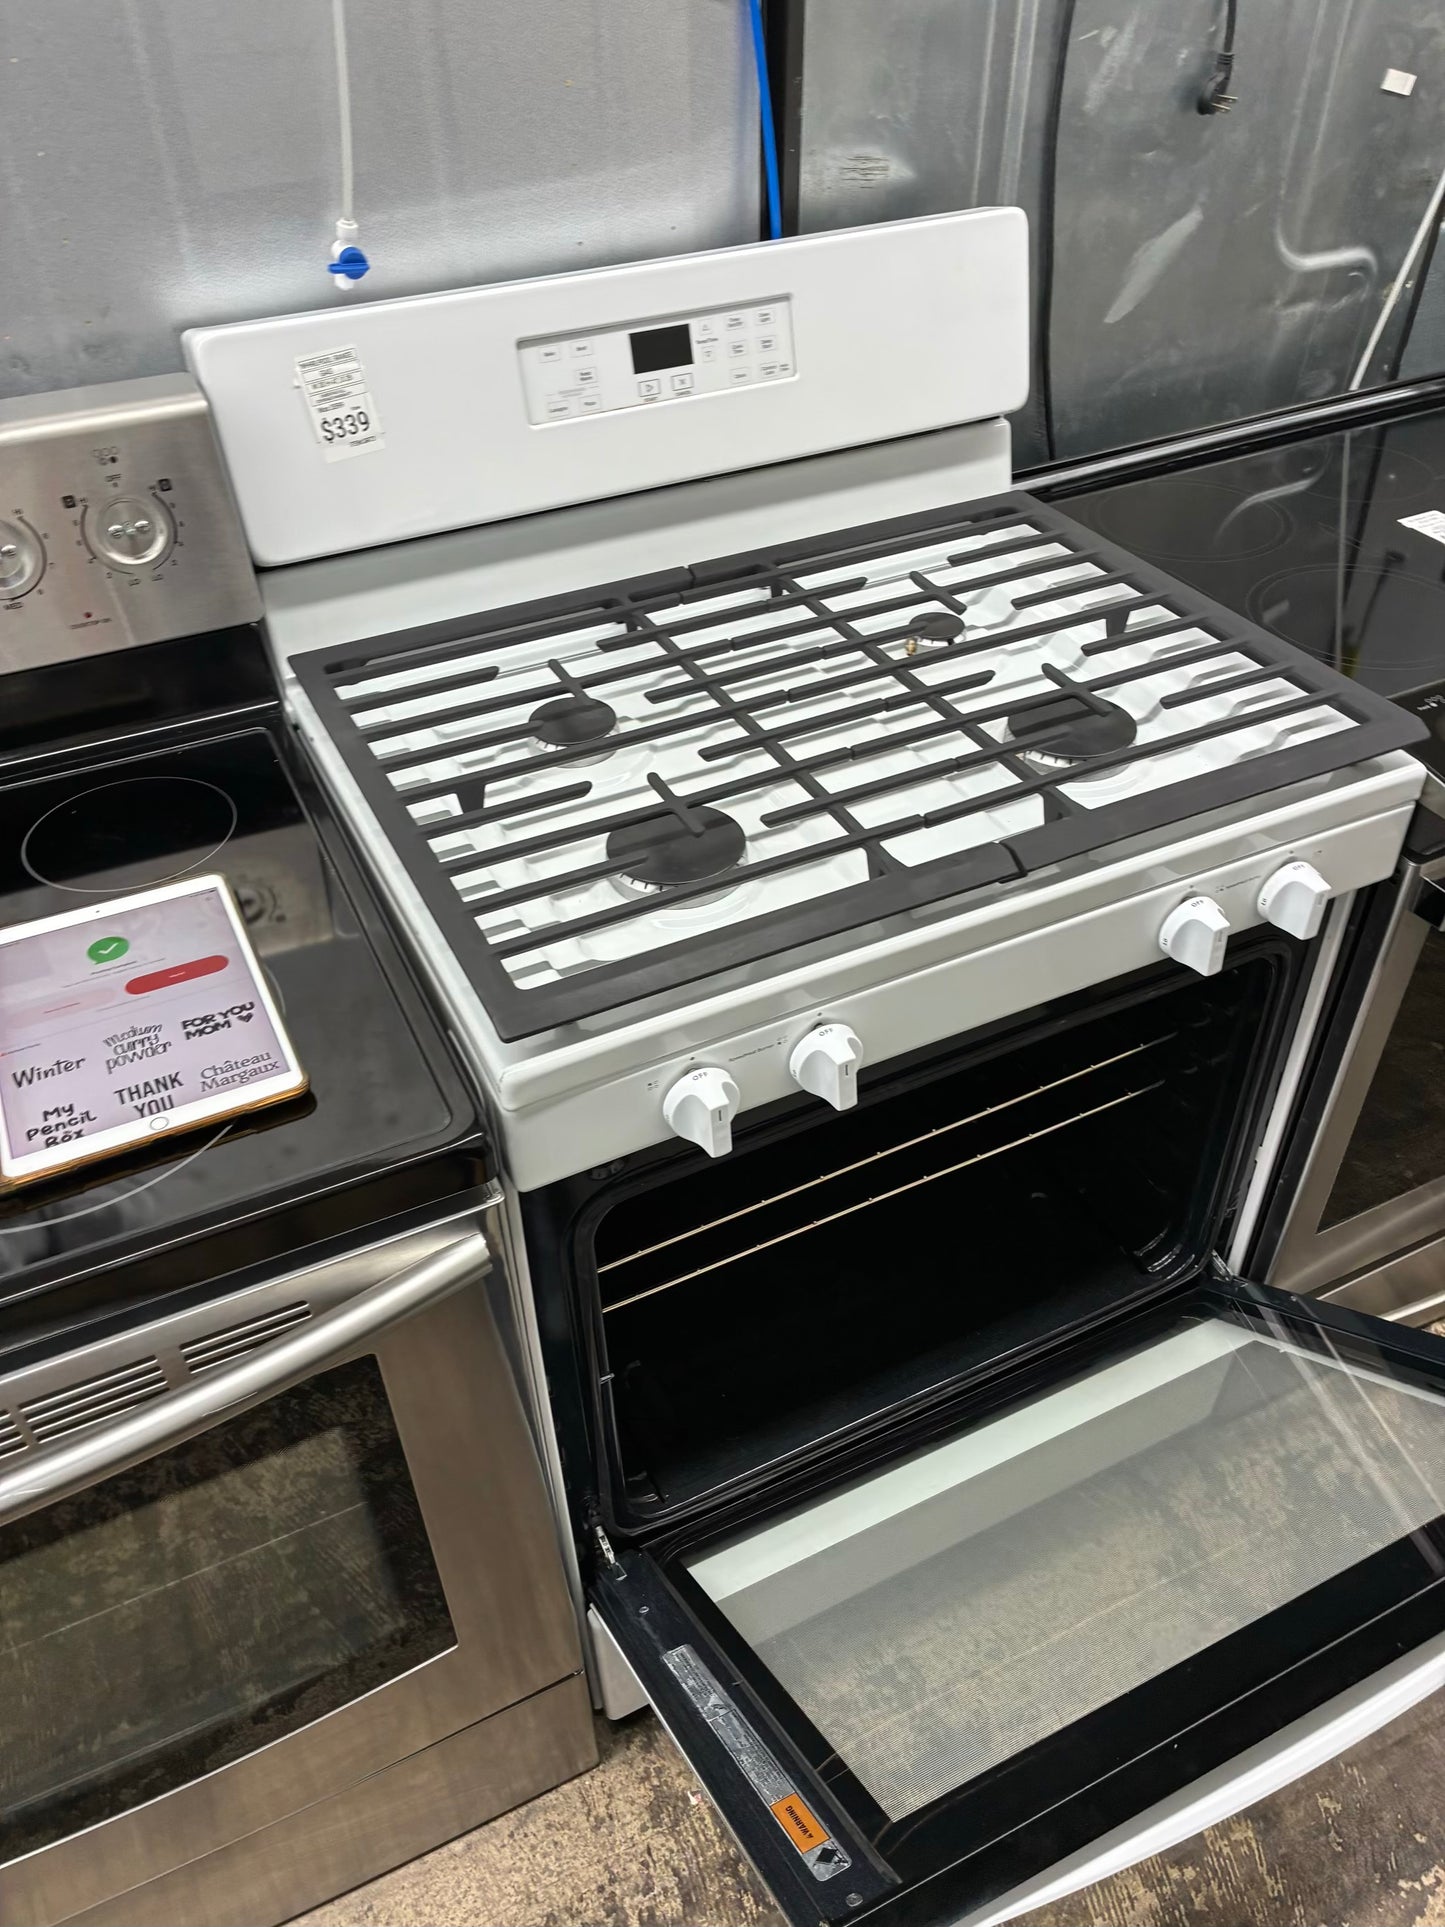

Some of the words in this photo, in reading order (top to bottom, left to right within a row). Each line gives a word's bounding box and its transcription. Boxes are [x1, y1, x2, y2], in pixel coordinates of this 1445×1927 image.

[320, 411, 370, 443] $339
[181, 1013, 217, 1030] FOR
[217, 1001, 255, 1019] YOU
[184, 1020, 232, 1040] MOM
[105, 1041, 173, 1075] powder
[113, 1033, 160, 1055] curry
[12, 1057, 87, 1088] Winter
[200, 1061, 280, 1092] Margaux
[201, 1052, 272, 1079] Château
[692, 1072, 708, 1081] OFF
[113, 1071, 184, 1105] THANK
[42, 1103, 74, 1122] My
[133, 1094, 175, 1118] YOU
[785, 1804, 810, 1836] WARNING
